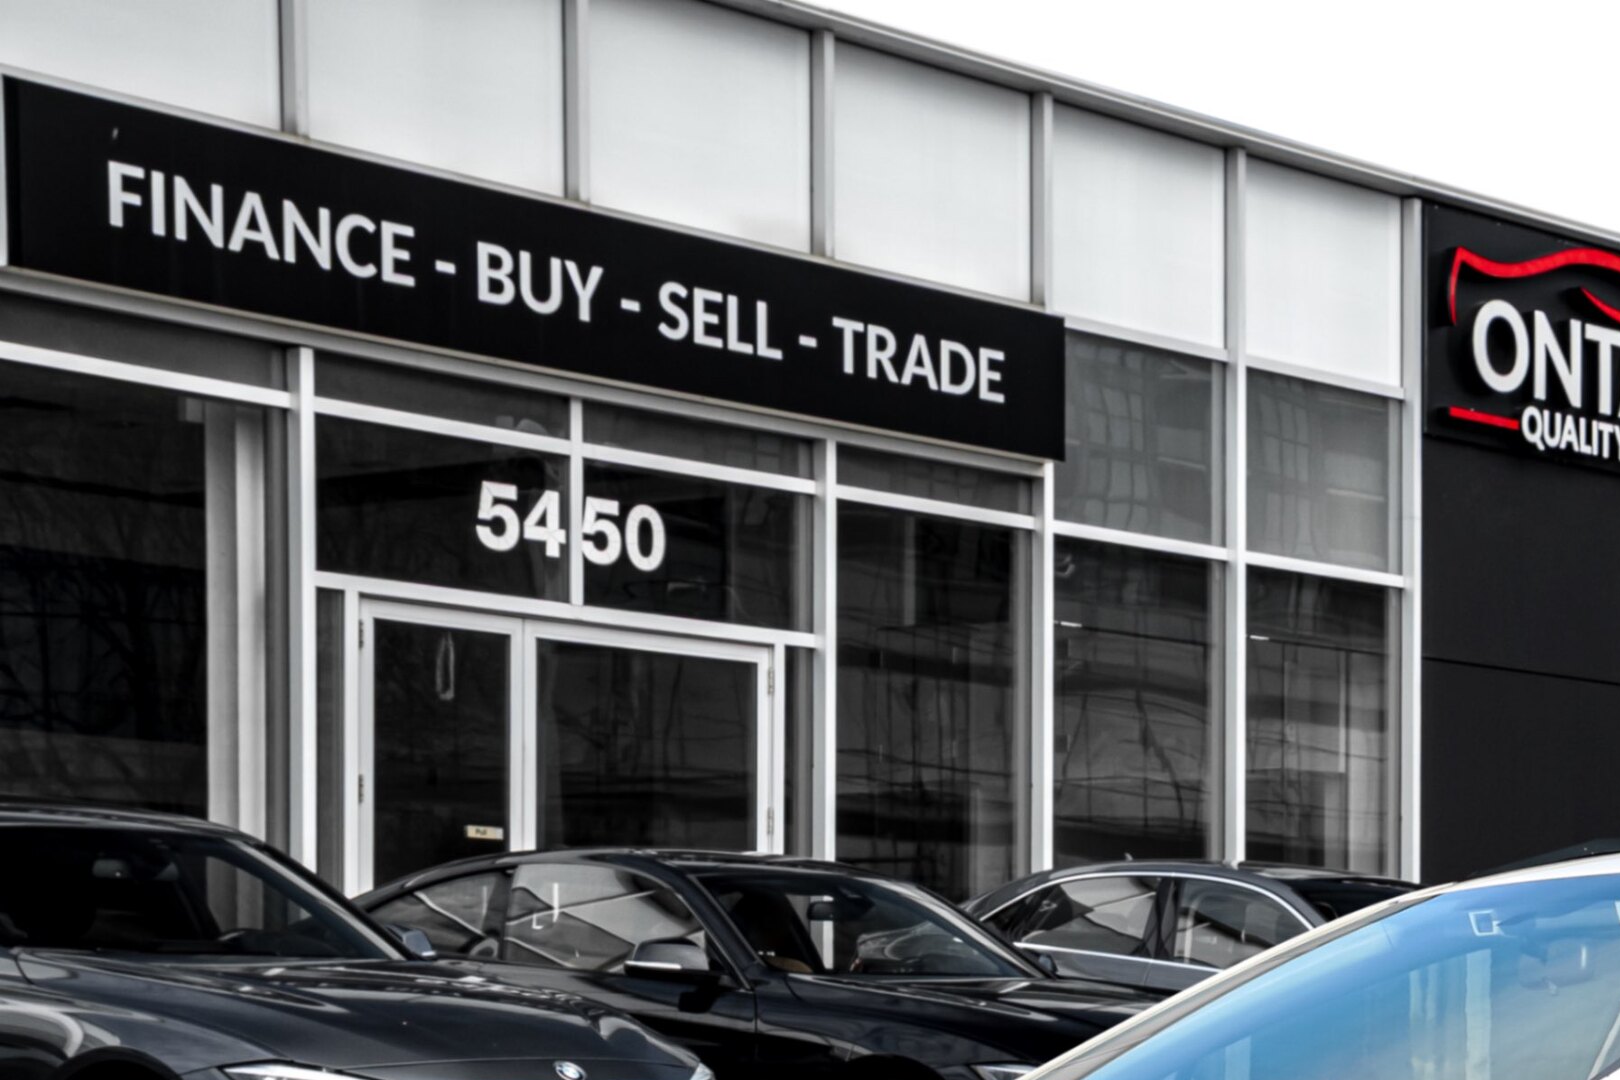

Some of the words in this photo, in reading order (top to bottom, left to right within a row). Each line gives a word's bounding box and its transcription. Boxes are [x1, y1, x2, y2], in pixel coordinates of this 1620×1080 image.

[107, 160, 416, 287] FINANCE
[476, 241, 603, 322] BUY
[658, 281, 783, 361] SELL
[832, 316, 1005, 404] TRADE
[475, 480, 666, 572] 5450
